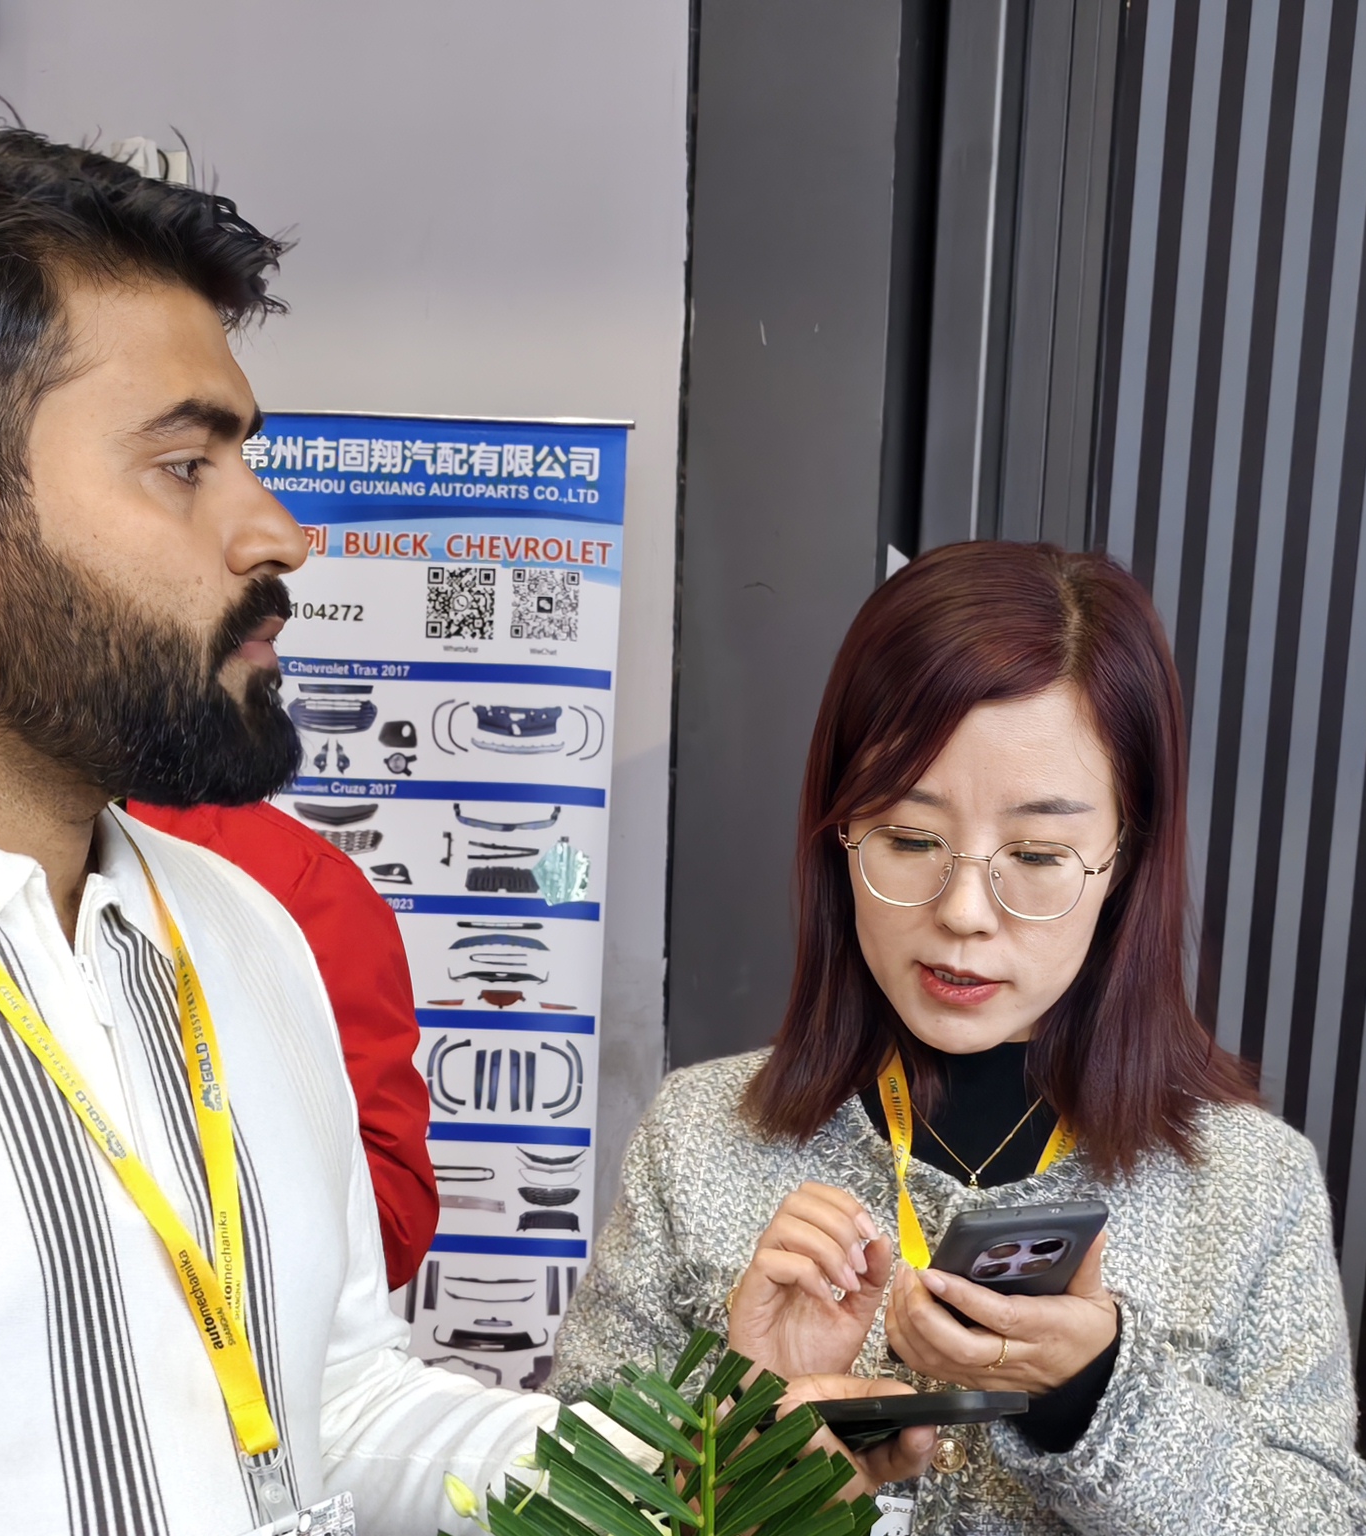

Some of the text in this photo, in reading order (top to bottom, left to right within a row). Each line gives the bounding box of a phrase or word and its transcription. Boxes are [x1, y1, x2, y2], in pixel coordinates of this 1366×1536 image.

[242, 435, 600, 481] 常州市固翔汽配有限公司
[349, 480, 425, 496] GUXIANG
[429, 483, 529, 499] AUTOPARTS
[533, 486, 599, 503] CO.,LTD
[344, 531, 430, 558] BUICK
[445, 534, 613, 566] CHEVROLET
[443, 645, 478, 653] WhatsApp
[288, 661, 410, 677] Chevrolet Trax 2017
[331, 782, 396, 795] Cruze 2017
[199, 1042, 215, 1083] GOLD
[178, 1249, 225, 1351] automechanika
[215, 1306, 237, 1347] SHANGHAI
